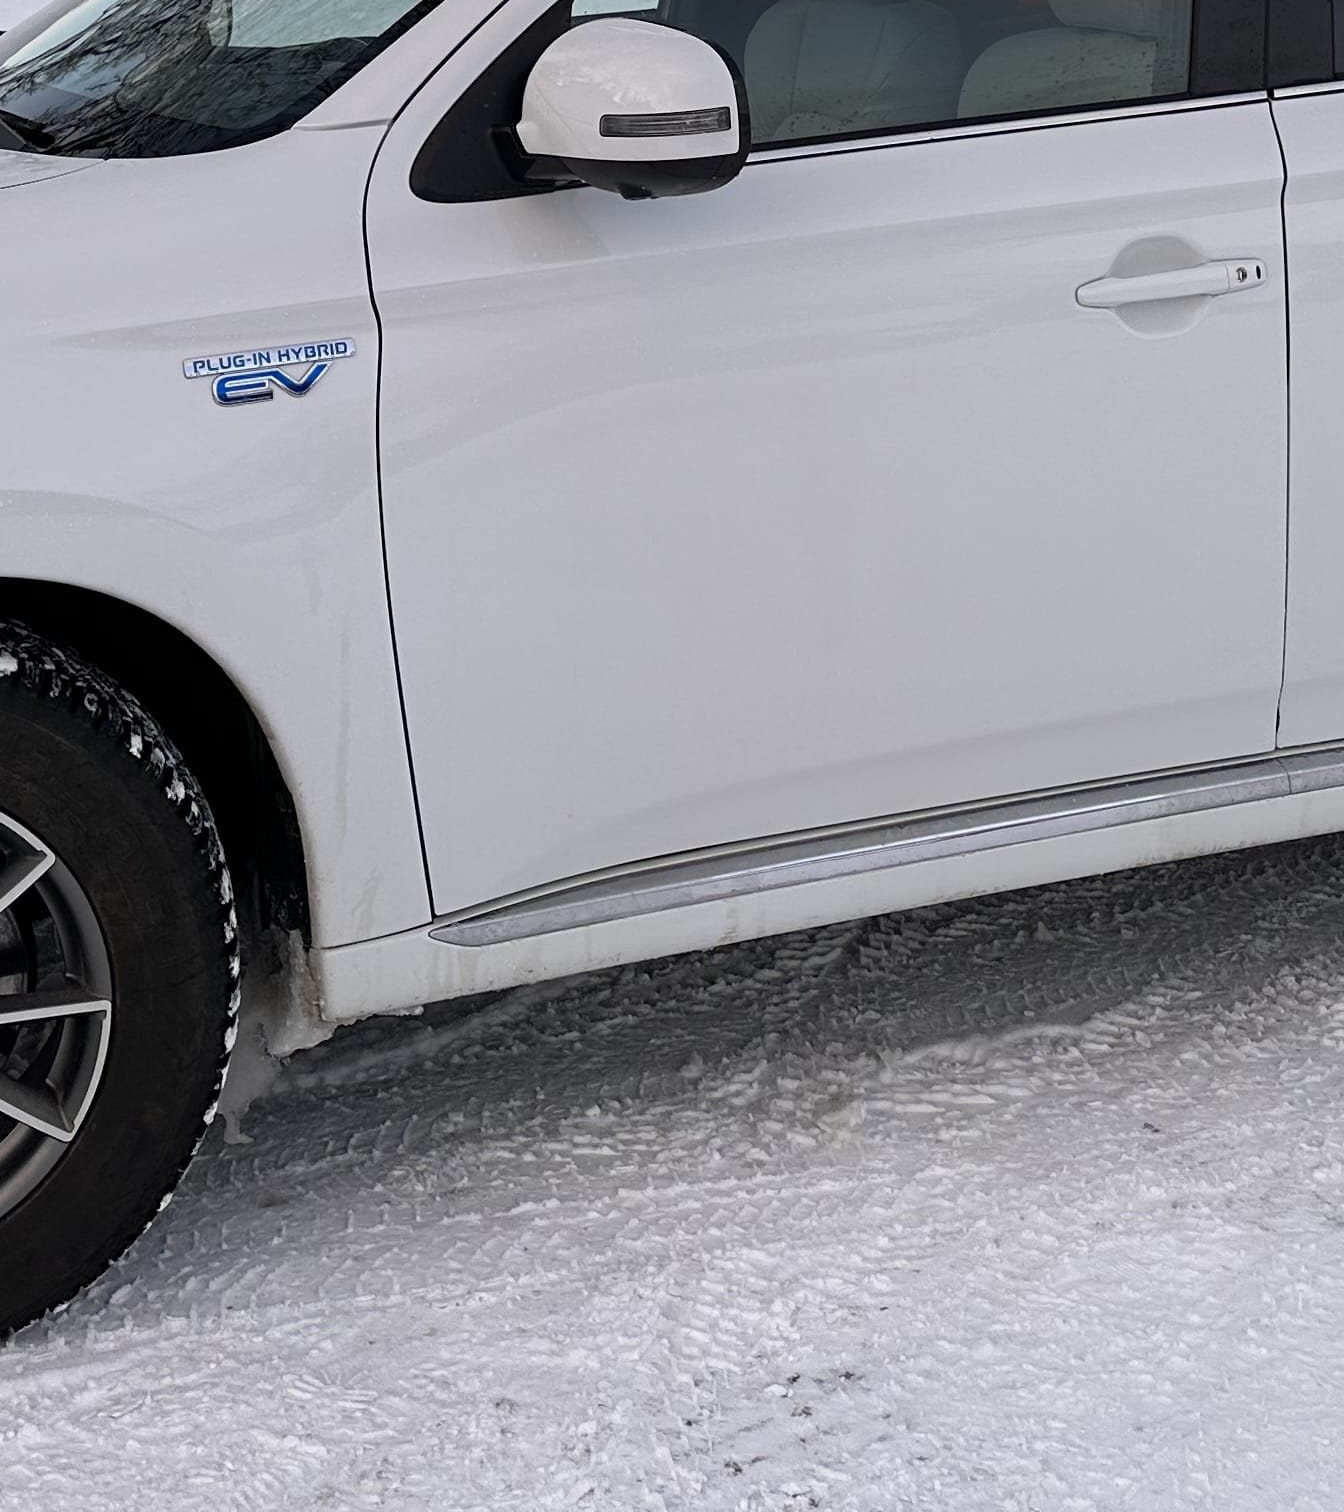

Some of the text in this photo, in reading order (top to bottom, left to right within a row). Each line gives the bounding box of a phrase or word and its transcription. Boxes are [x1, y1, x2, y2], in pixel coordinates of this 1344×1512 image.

[192, 341, 348, 374] PLUG-IN HYBRID
[212, 360, 333, 407] EV
